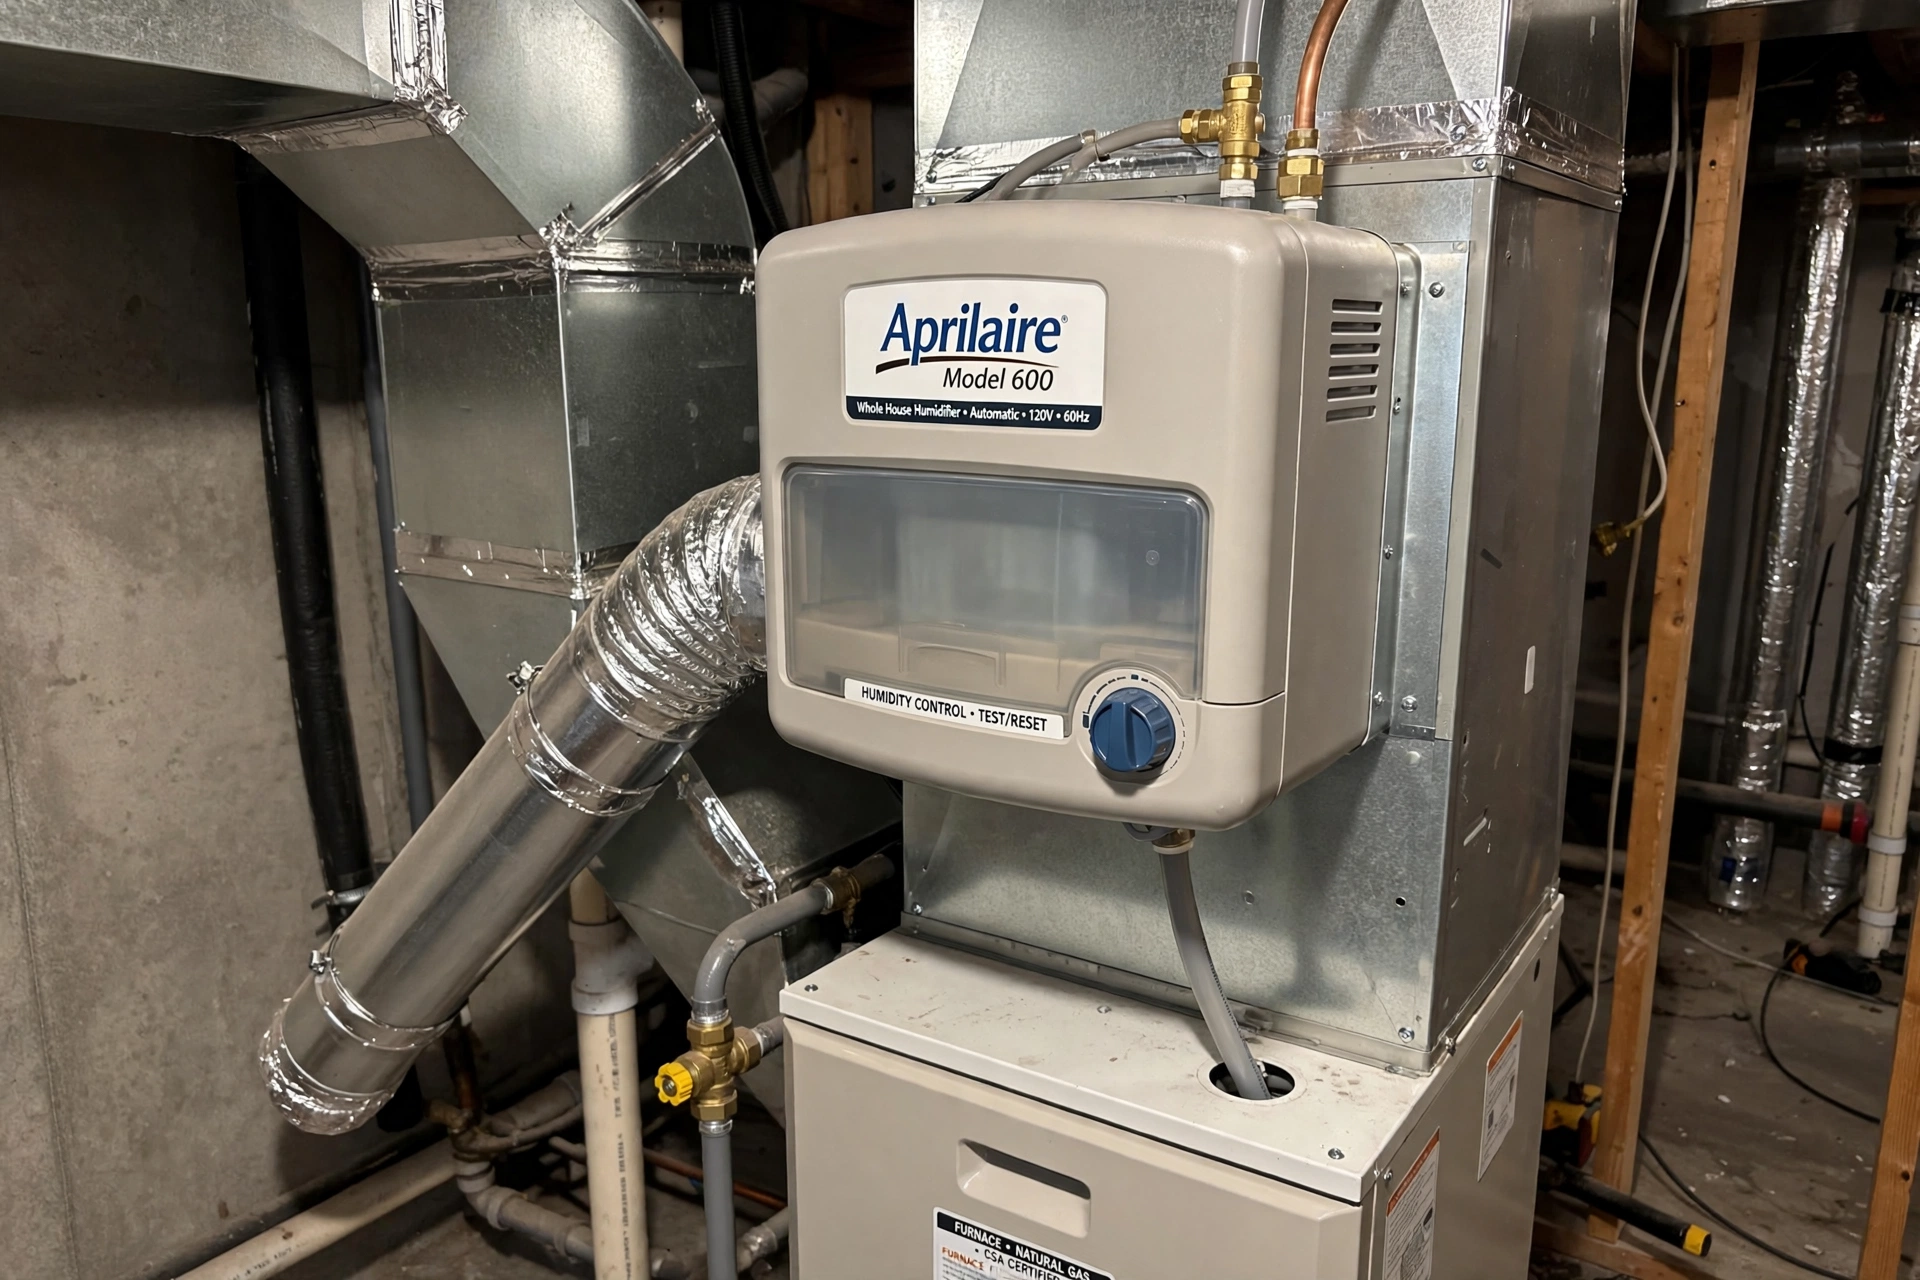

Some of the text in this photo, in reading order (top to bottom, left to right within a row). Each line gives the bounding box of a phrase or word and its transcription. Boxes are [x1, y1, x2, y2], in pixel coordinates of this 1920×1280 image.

[942, 367, 1054, 391] Model 600
[856, 401, 1090, 423] Whole House Humidifier Automatic 120V 60Hz
[861, 685, 1048, 732] HUMIDITY CONTROL TEST/RESET
[954, 1221, 1002, 1250] FURNACE
[1015, 1244, 1065, 1275] NATURAL
[1067, 1265, 1090, 1280] GAS
[984, 1249, 1005, 1266] CSA
